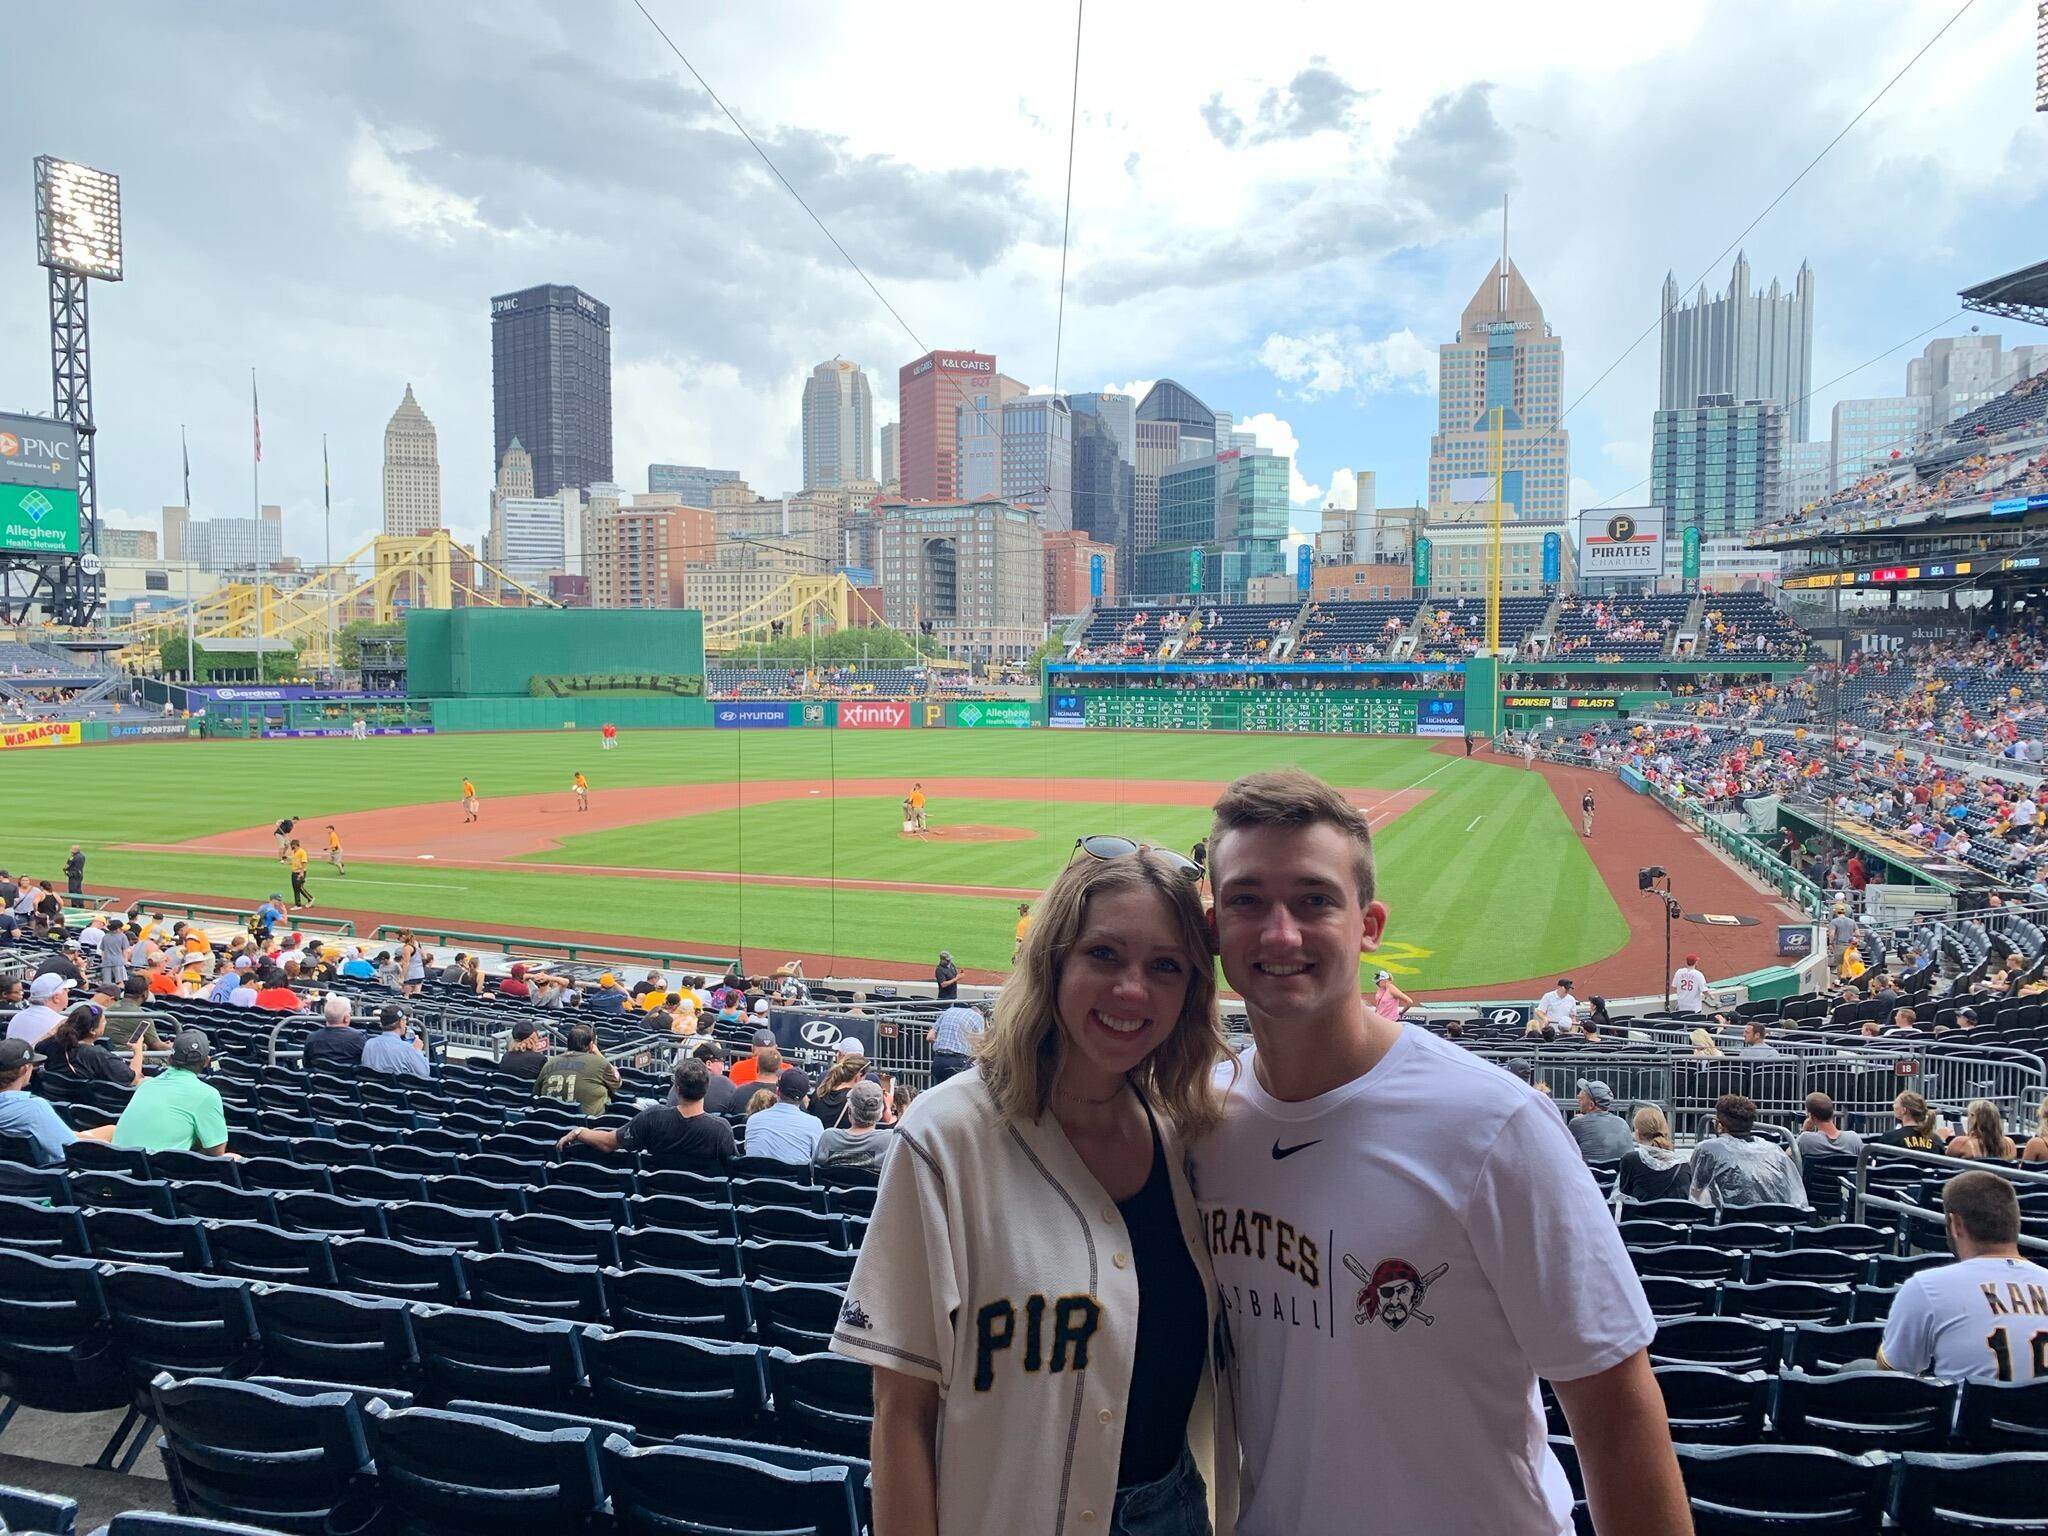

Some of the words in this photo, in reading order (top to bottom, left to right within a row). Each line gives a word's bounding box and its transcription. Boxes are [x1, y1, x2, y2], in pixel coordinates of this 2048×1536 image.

[577, 295, 597, 314] UPMC
[942, 358, 960, 369] K&L
[960, 360, 991, 371] GATES
[21, 437, 70, 460] PNC
[5, 524, 67, 541] Allegheny
[1616, 520, 1629, 538] P
[5, 539, 33, 547] Health
[33, 540, 66, 550] Network
[1591, 546, 1651, 558] PIRATES
[1591, 558, 1650, 567] CHARITIES
[1883, 571, 1896, 580] LAA
[1931, 566, 1945, 576] SEA
[1912, 627, 1944, 639] skull
[1860, 634, 1905, 654] lite
[1512, 698, 1551, 707] BOWSER
[1578, 698, 1615, 707] BLASTS
[739, 711, 785, 721] HYUNDAI
[843, 705, 905, 727] xfinity
[926, 705, 942, 726] P
[985, 708, 1030, 720] Allegheny
[1424, 716, 1459, 724] HIGHMARK
[4, 724, 70, 746] W.B.MASON
[141, 725, 187, 735] SPORTSNET
[1680, 979, 1694, 991] 26
[1901, 1063, 1912, 1073] 18
[546, 1074, 577, 1102] 21
[1903, 1136, 1933, 1150] KANG
[1199, 1208, 1320, 1288] IRATES
[973, 1293, 1102, 1392] PIR
